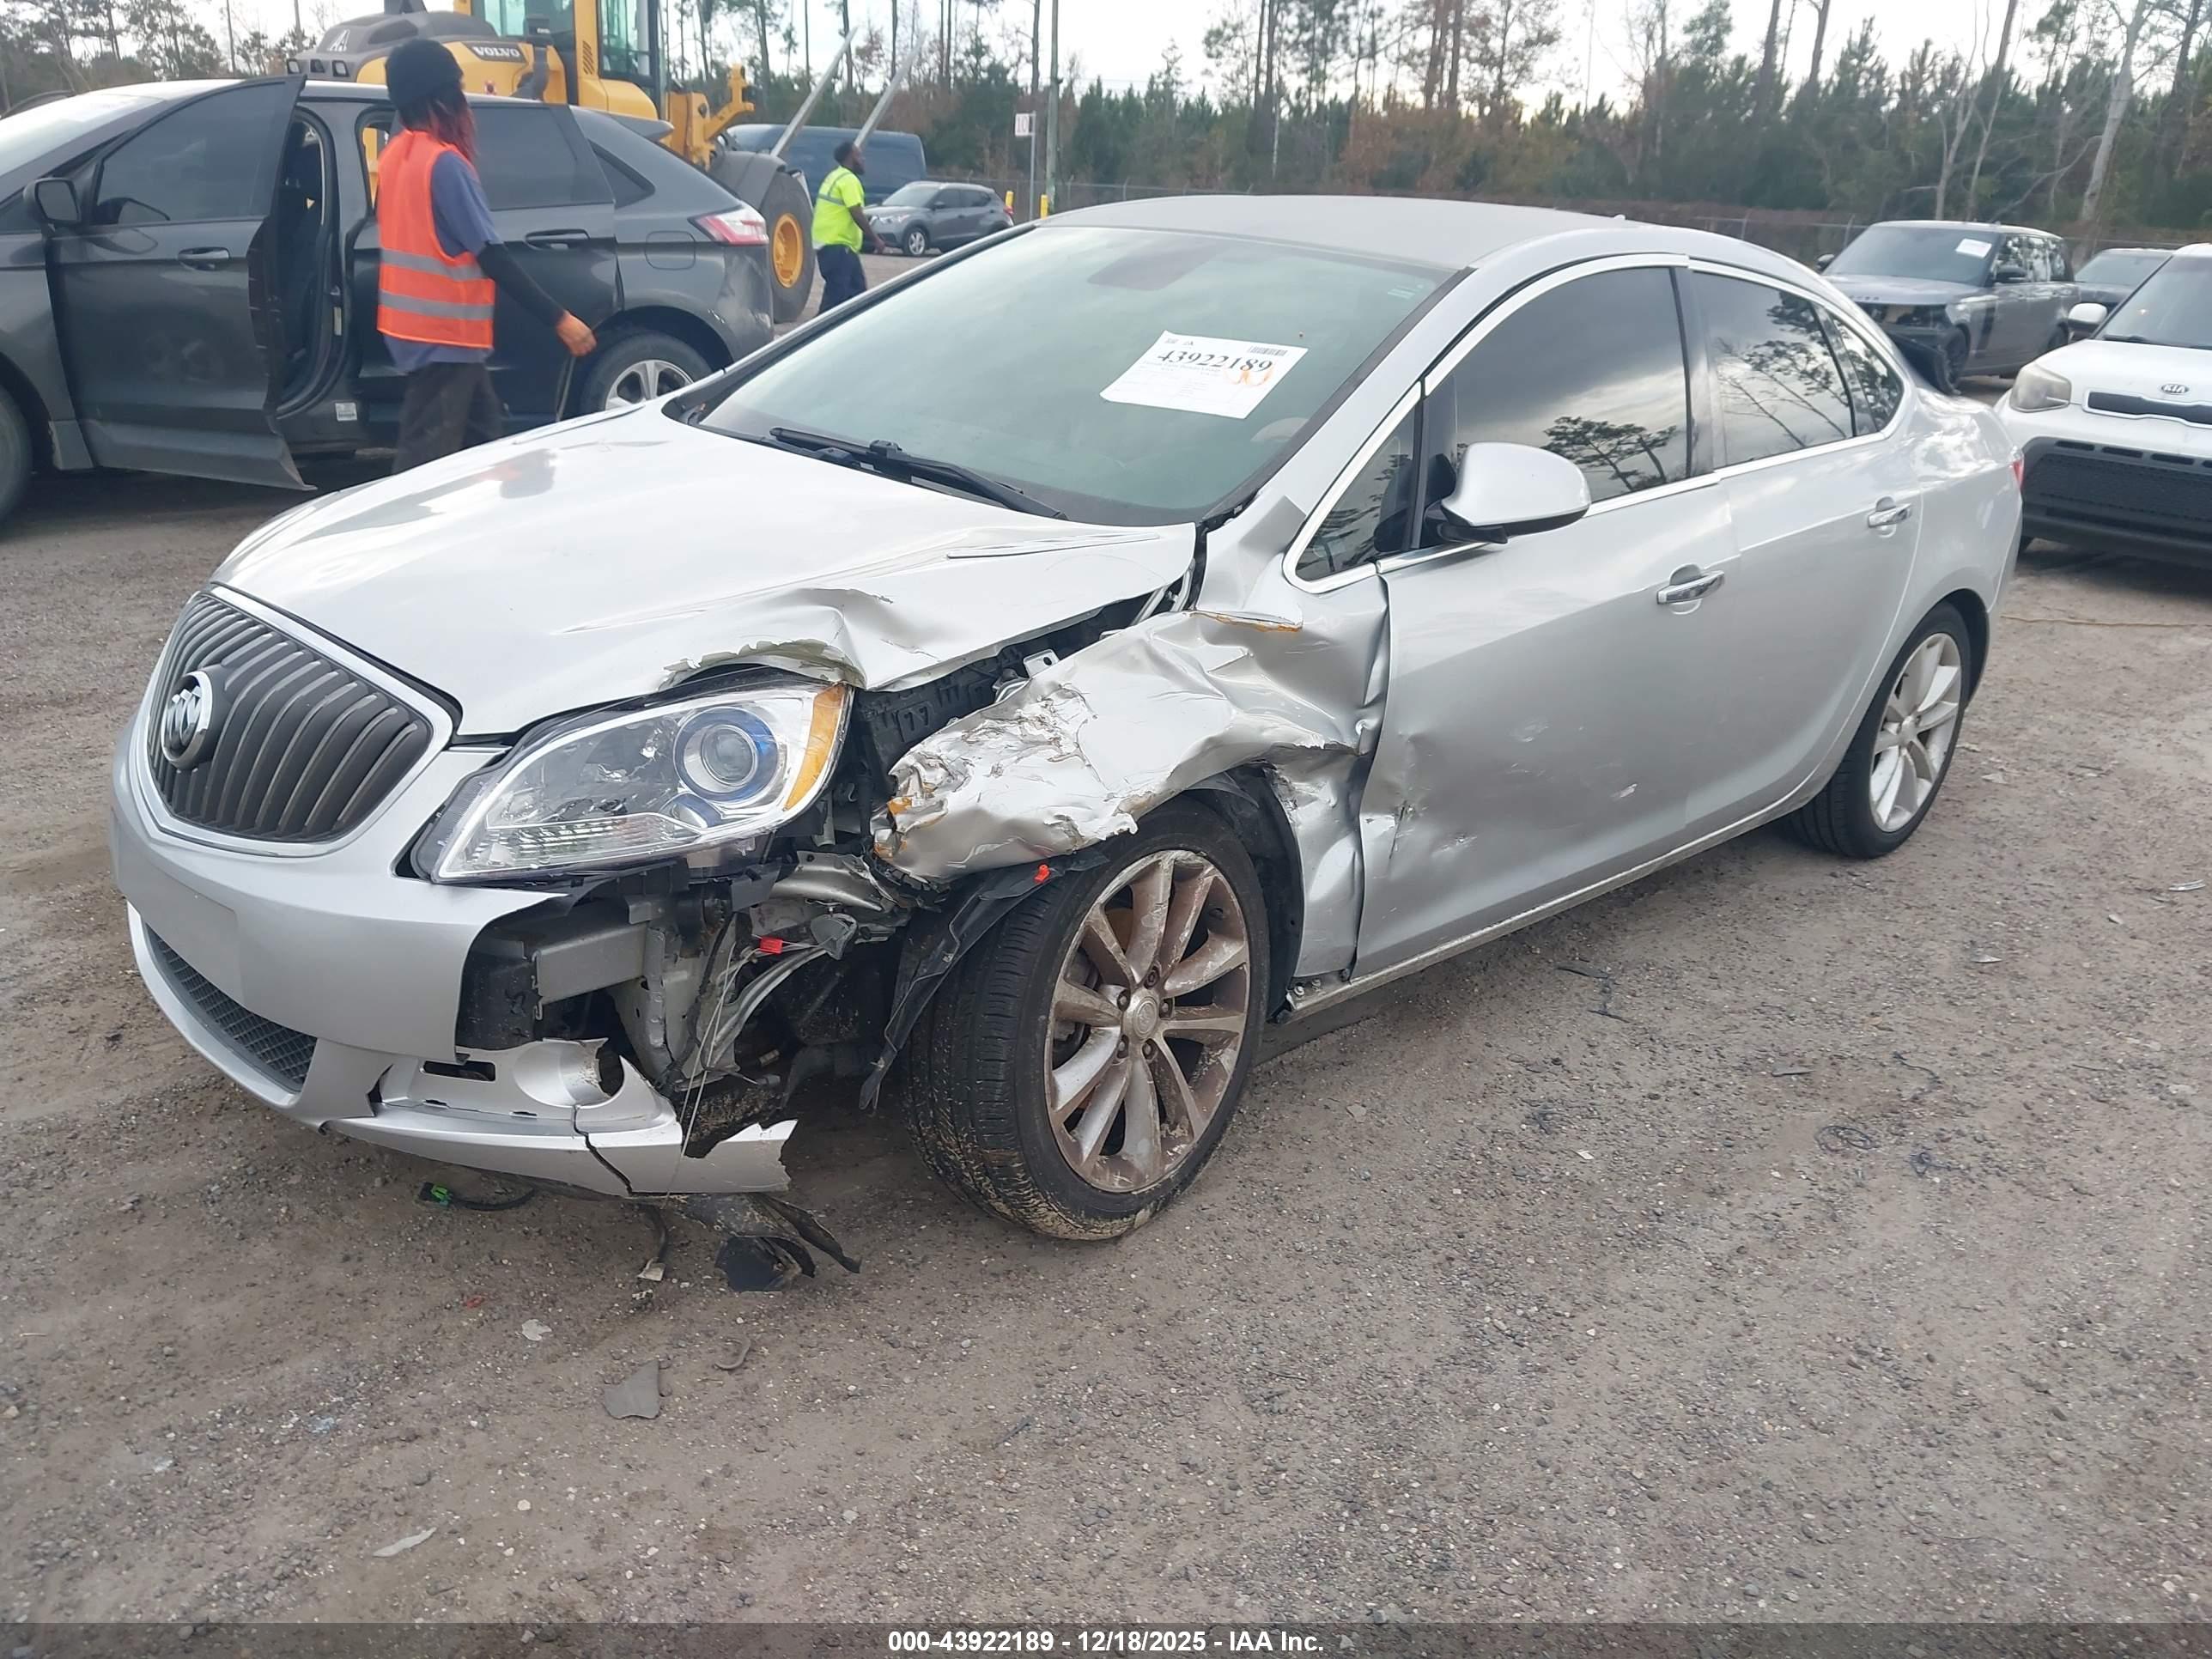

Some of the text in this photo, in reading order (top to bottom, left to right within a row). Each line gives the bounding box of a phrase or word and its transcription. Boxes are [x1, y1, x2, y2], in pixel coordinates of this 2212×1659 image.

[472, 46, 520, 58] VOLVO
[1158, 349, 1273, 373] 43922189
[2163, 384, 2185, 393] KIA
